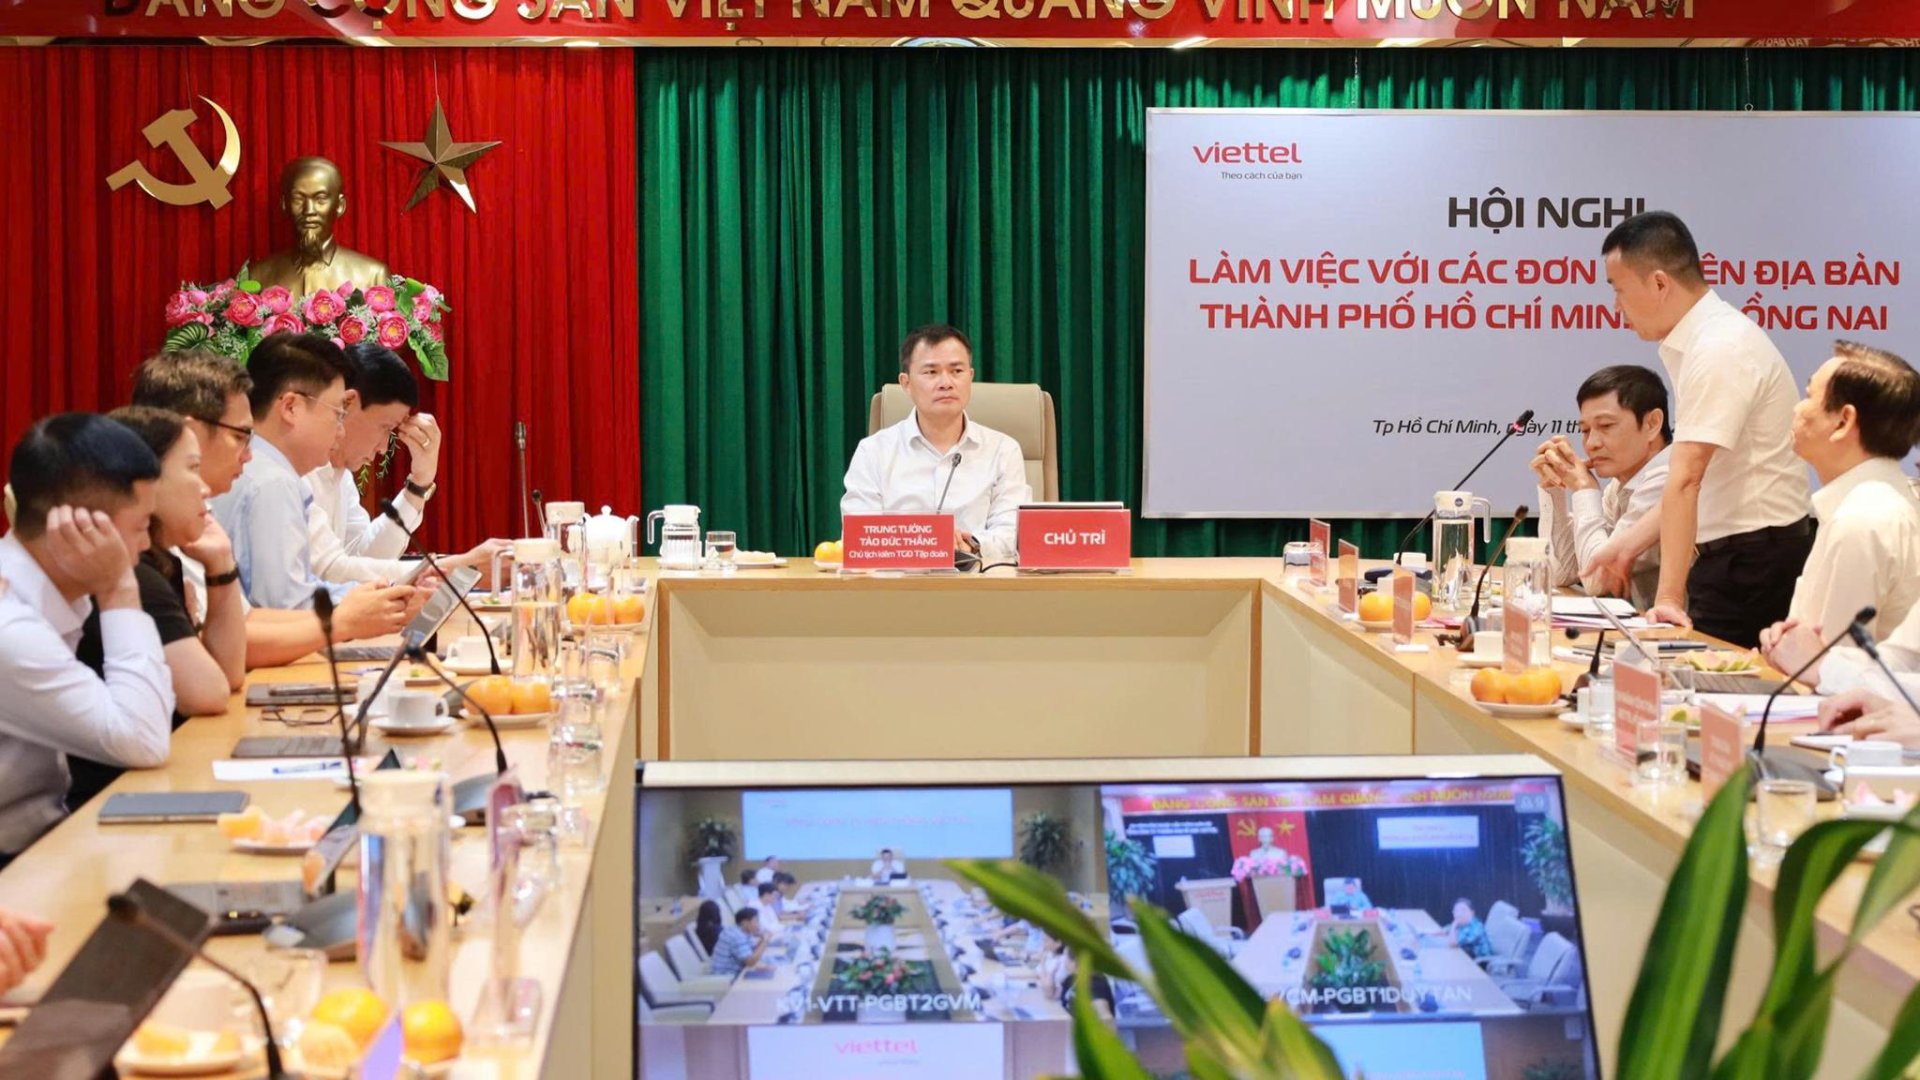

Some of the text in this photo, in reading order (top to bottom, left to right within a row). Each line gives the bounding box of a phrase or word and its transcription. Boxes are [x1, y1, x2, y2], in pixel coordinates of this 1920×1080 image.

[1192, 141, 1303, 164] viettel
[1221, 171, 1243, 180] Theo
[1448, 187, 1525, 234] HỘI
[1189, 250, 1271, 284] LÀM
[1280, 251, 1359, 289] VIỆC
[1368, 250, 1428, 284] VỚI
[1438, 250, 1508, 284] CÁC
[1515, 256, 1597, 284] ĐƠN
[1754, 260, 1816, 290] ĐỊA
[1824, 252, 1900, 286] BÀN
[1200, 290, 1888, 330] THÀNH PHỐ HỒ CHÍ MIN ỒNG NAI
[1373, 420, 1394, 436] Tp
[1397, 416, 1422, 433] Hồ
[1426, 419, 1454, 433] Chí
[1455, 419, 1501, 435] Minh,
[863, 525, 897, 534] TRUNG
[1044, 527, 1106, 545] CHỦ TRÌ
